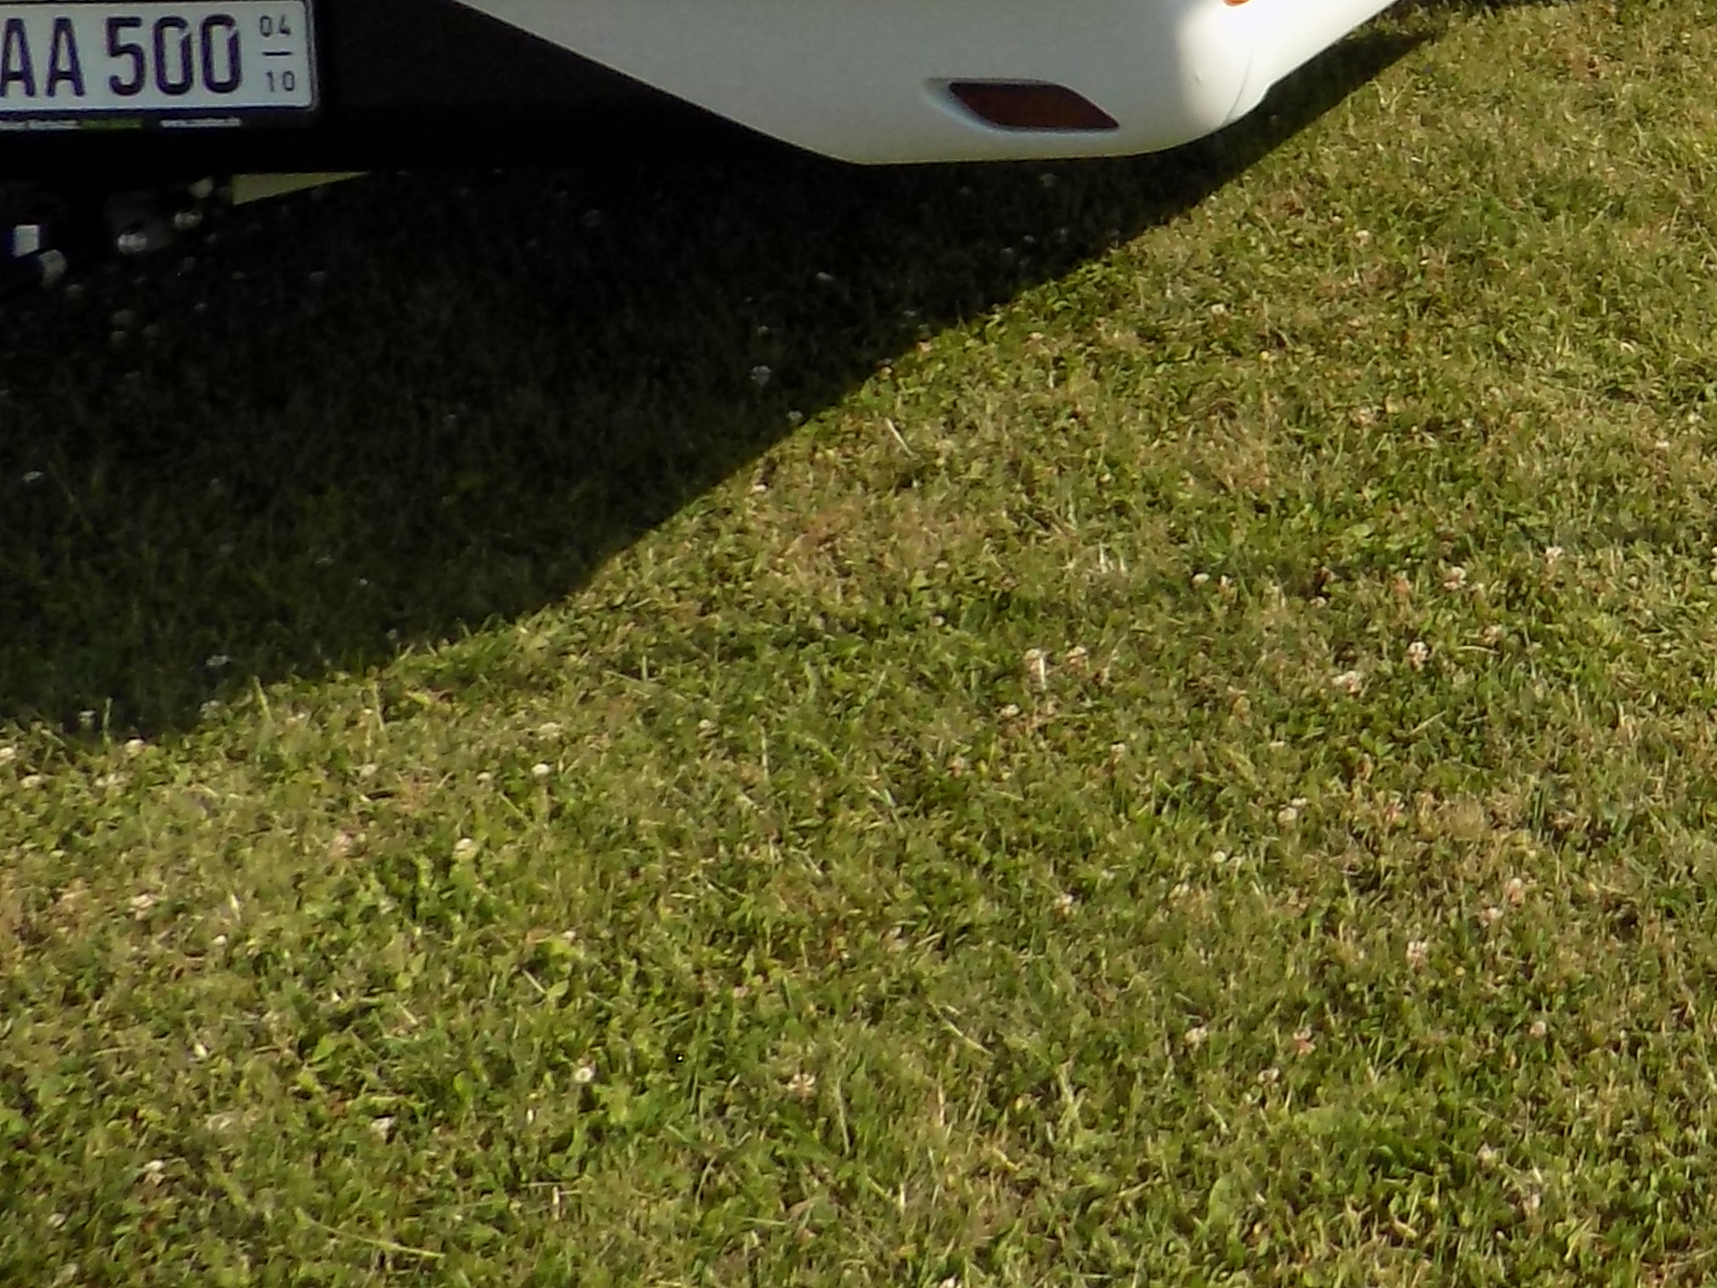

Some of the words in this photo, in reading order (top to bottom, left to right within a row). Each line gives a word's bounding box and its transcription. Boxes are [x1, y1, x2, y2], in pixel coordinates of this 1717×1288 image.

[259, 14, 293, 38] 04
[0, 16, 86, 98] AA
[105, 13, 243, 96] 500
[265, 70, 296, 93] 10
